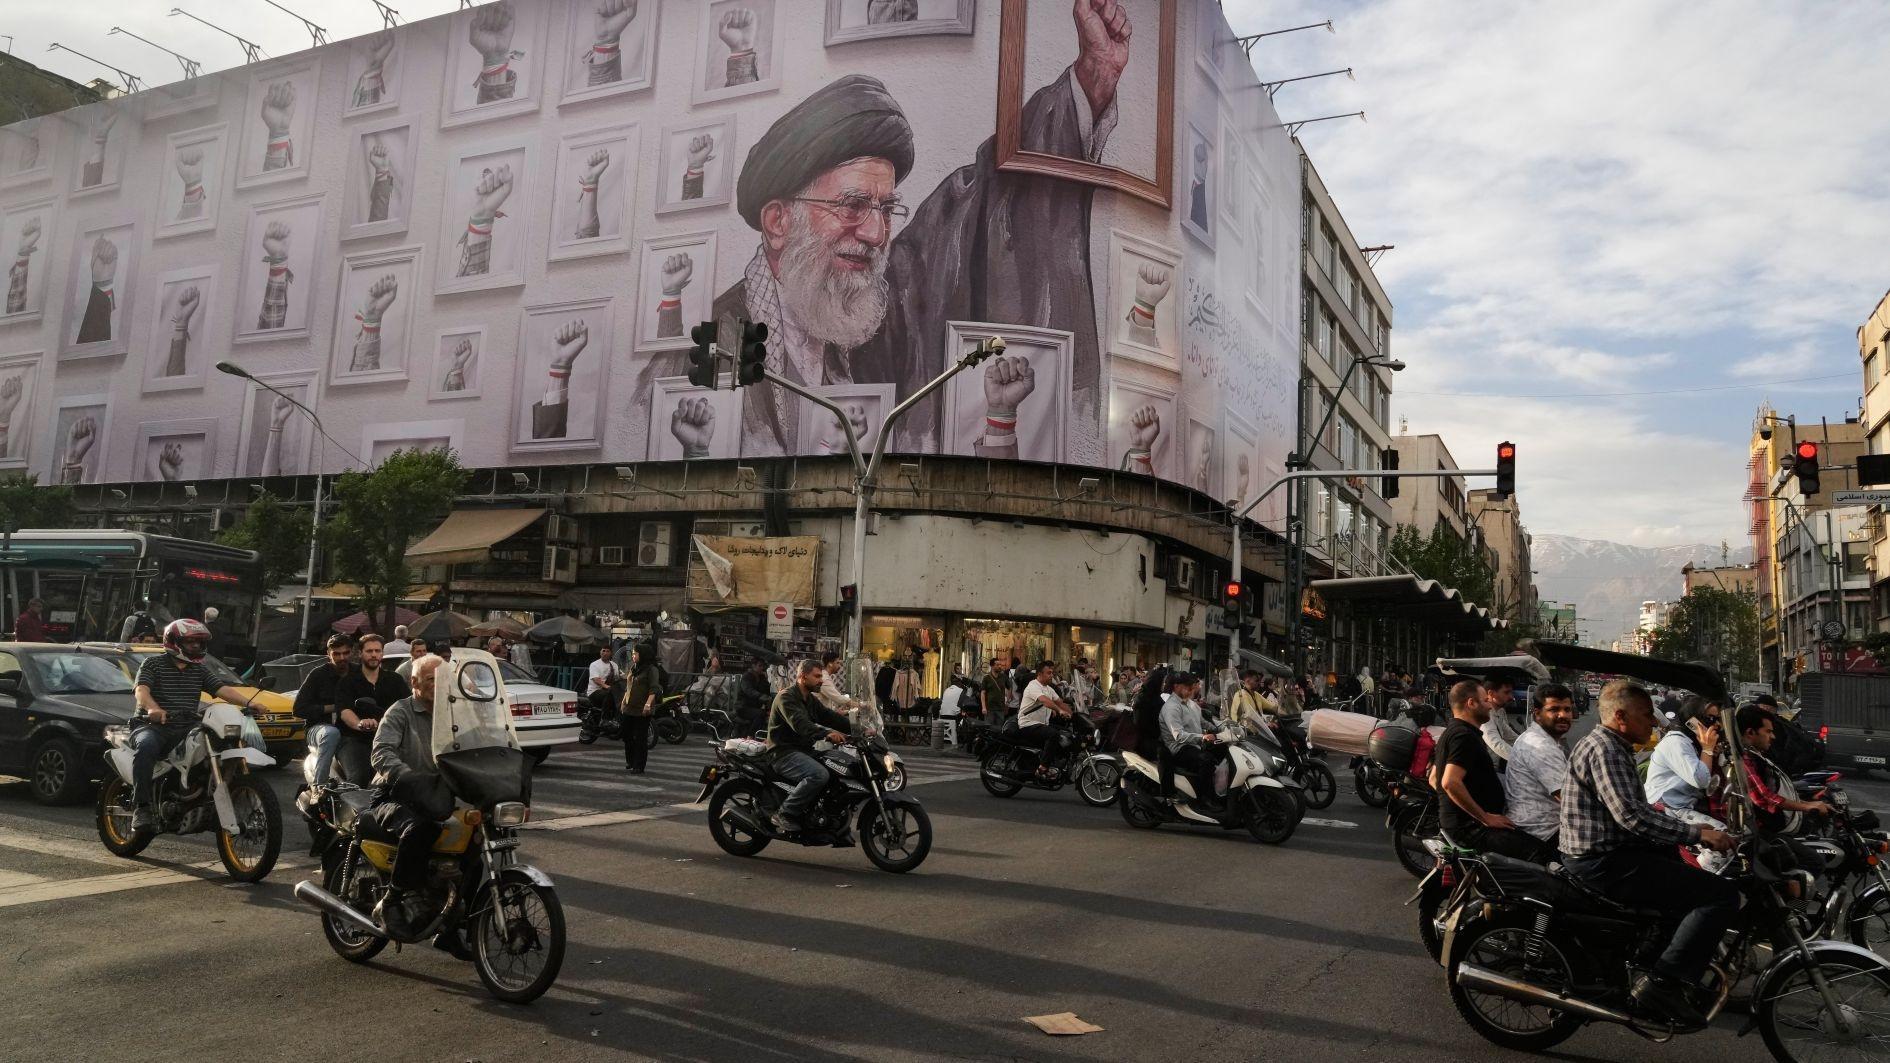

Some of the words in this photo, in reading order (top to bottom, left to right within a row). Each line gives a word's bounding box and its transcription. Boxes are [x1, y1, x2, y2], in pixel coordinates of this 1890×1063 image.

[1836, 493, 1865, 502] اسلامی
[741, 545, 768, 557] بدلیجات
[774, 546, 788, 555] لاک
[788, 546, 808, 558] دنیای
[825, 758, 848, 774] Benelli
